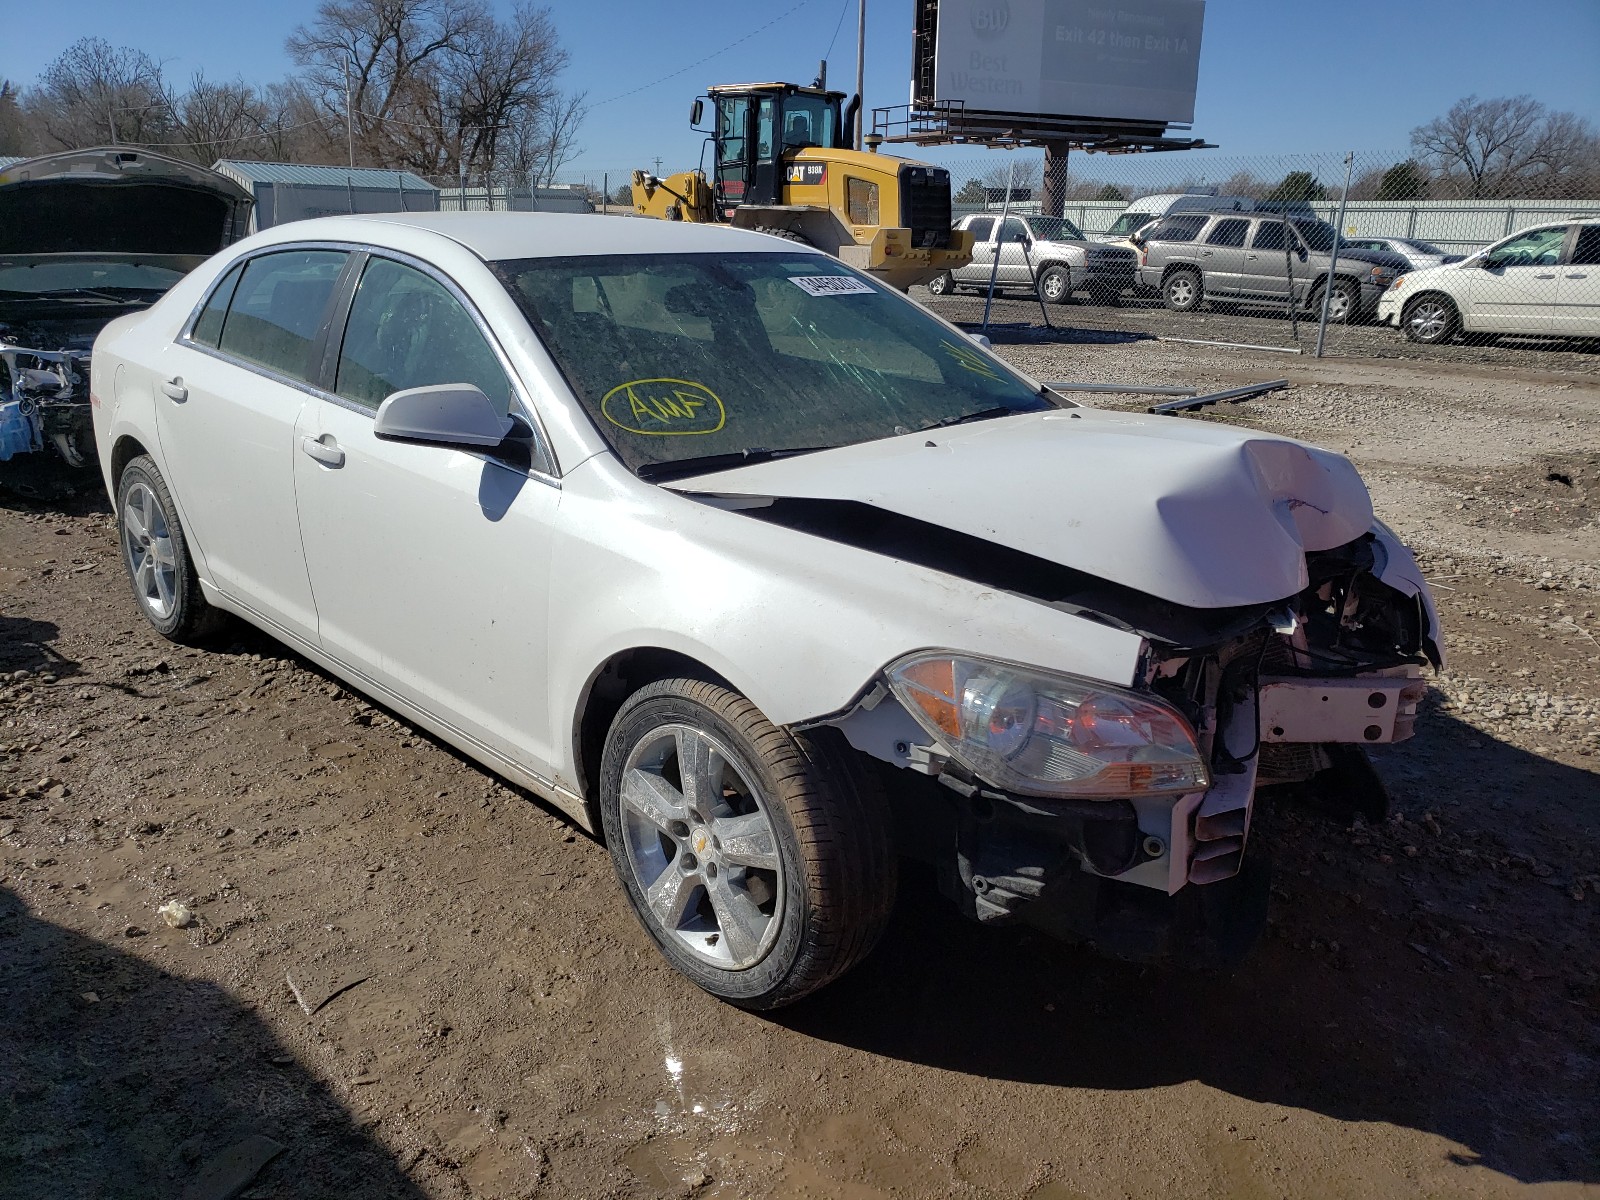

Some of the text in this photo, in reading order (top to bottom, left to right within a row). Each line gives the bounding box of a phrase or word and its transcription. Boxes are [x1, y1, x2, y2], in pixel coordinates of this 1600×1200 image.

[1055, 25, 1083, 43] Exit
[1087, 28, 1106, 45] 42
[1144, 34, 1171, 52] Exit
[1174, 38, 1189, 54] 1A
[970, 50, 1008, 73] Best
[950, 72, 1023, 95] Western
[786, 166, 805, 182] CAT
